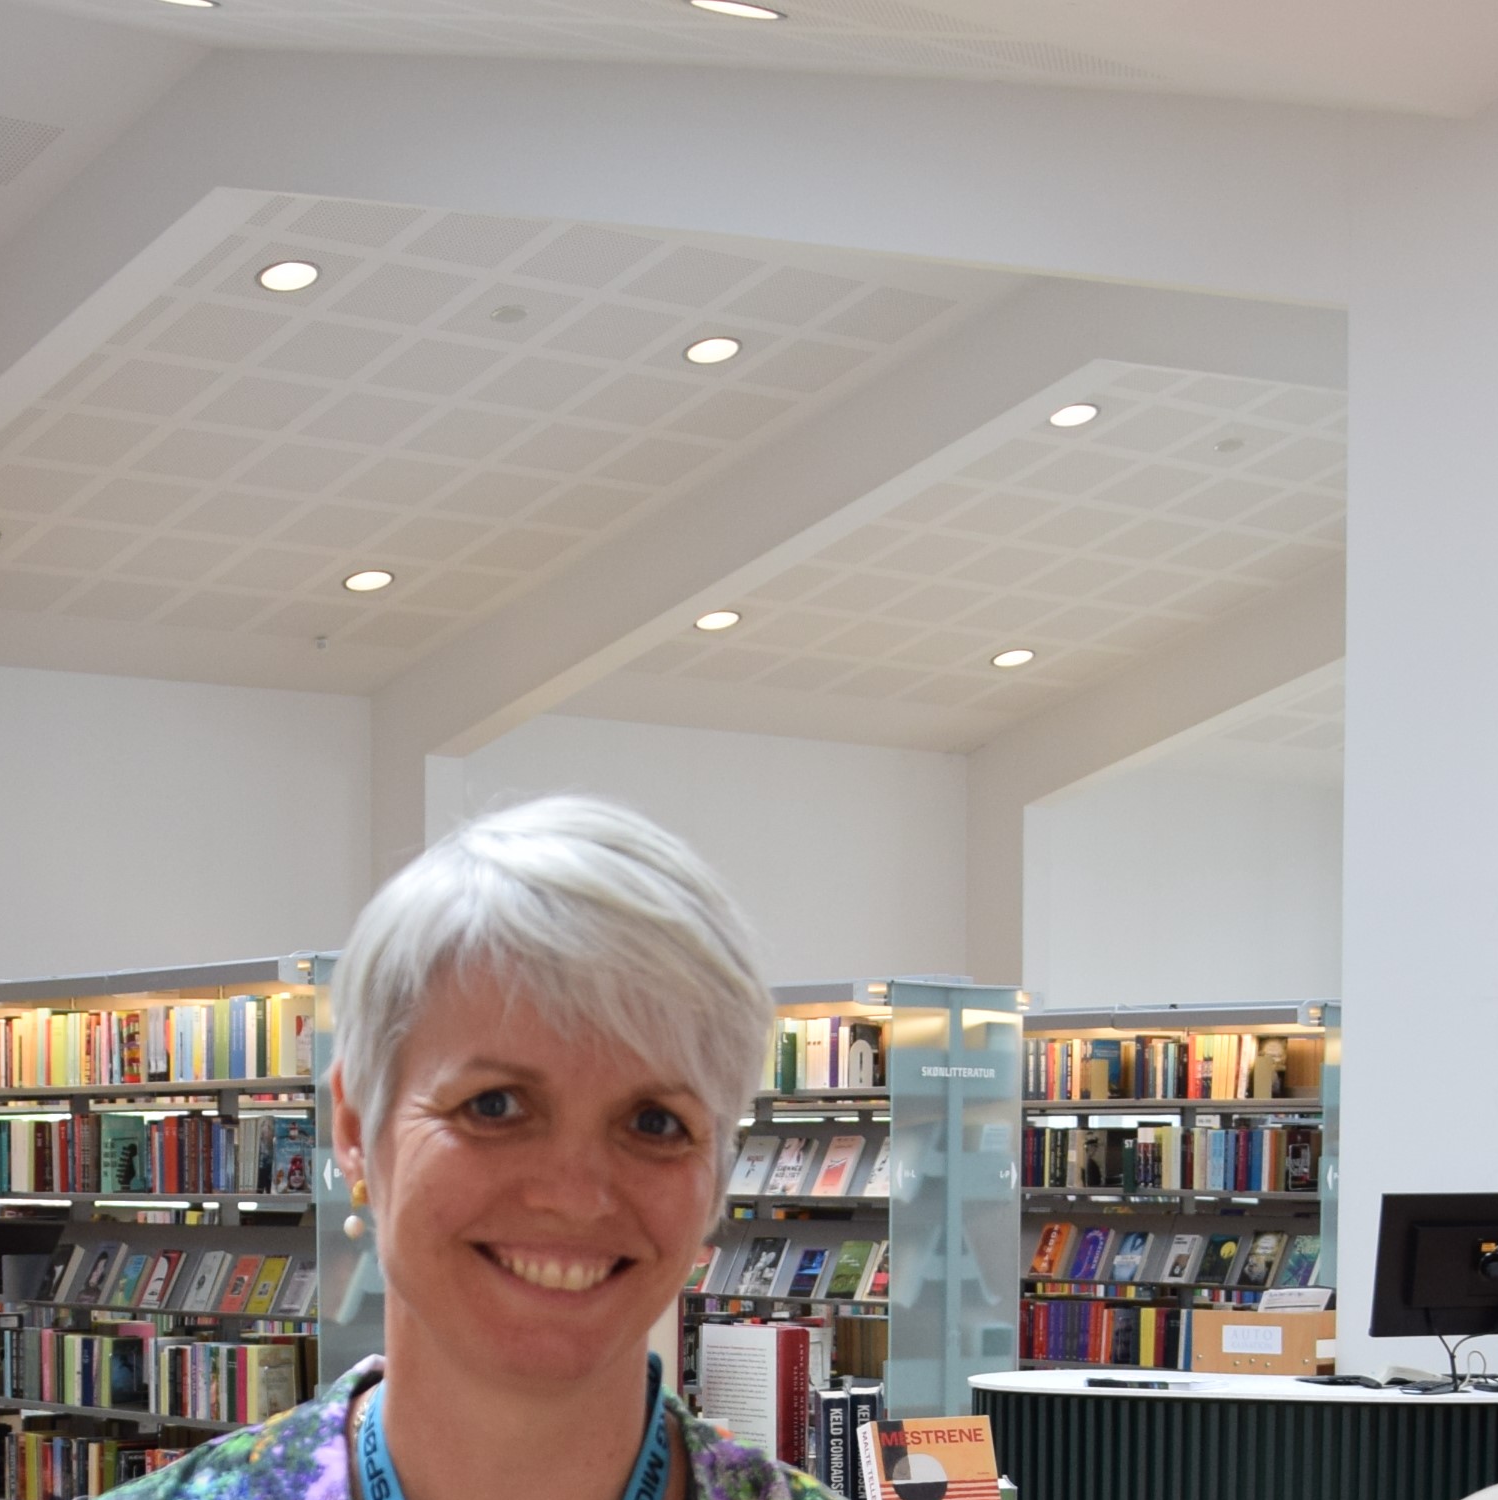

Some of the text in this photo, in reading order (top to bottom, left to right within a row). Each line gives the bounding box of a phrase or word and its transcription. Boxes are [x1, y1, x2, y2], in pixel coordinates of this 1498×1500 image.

[921, 1066, 995, 1078] SKØNLITTERATUR
[1124, 1138, 1134, 1149] ST
[333, 1167, 343, 1178] B-
[830, 1408, 843, 1435] KELD
[880, 1428, 984, 1447] MESTRENE
[862, 1431, 872, 1467] MALTE
